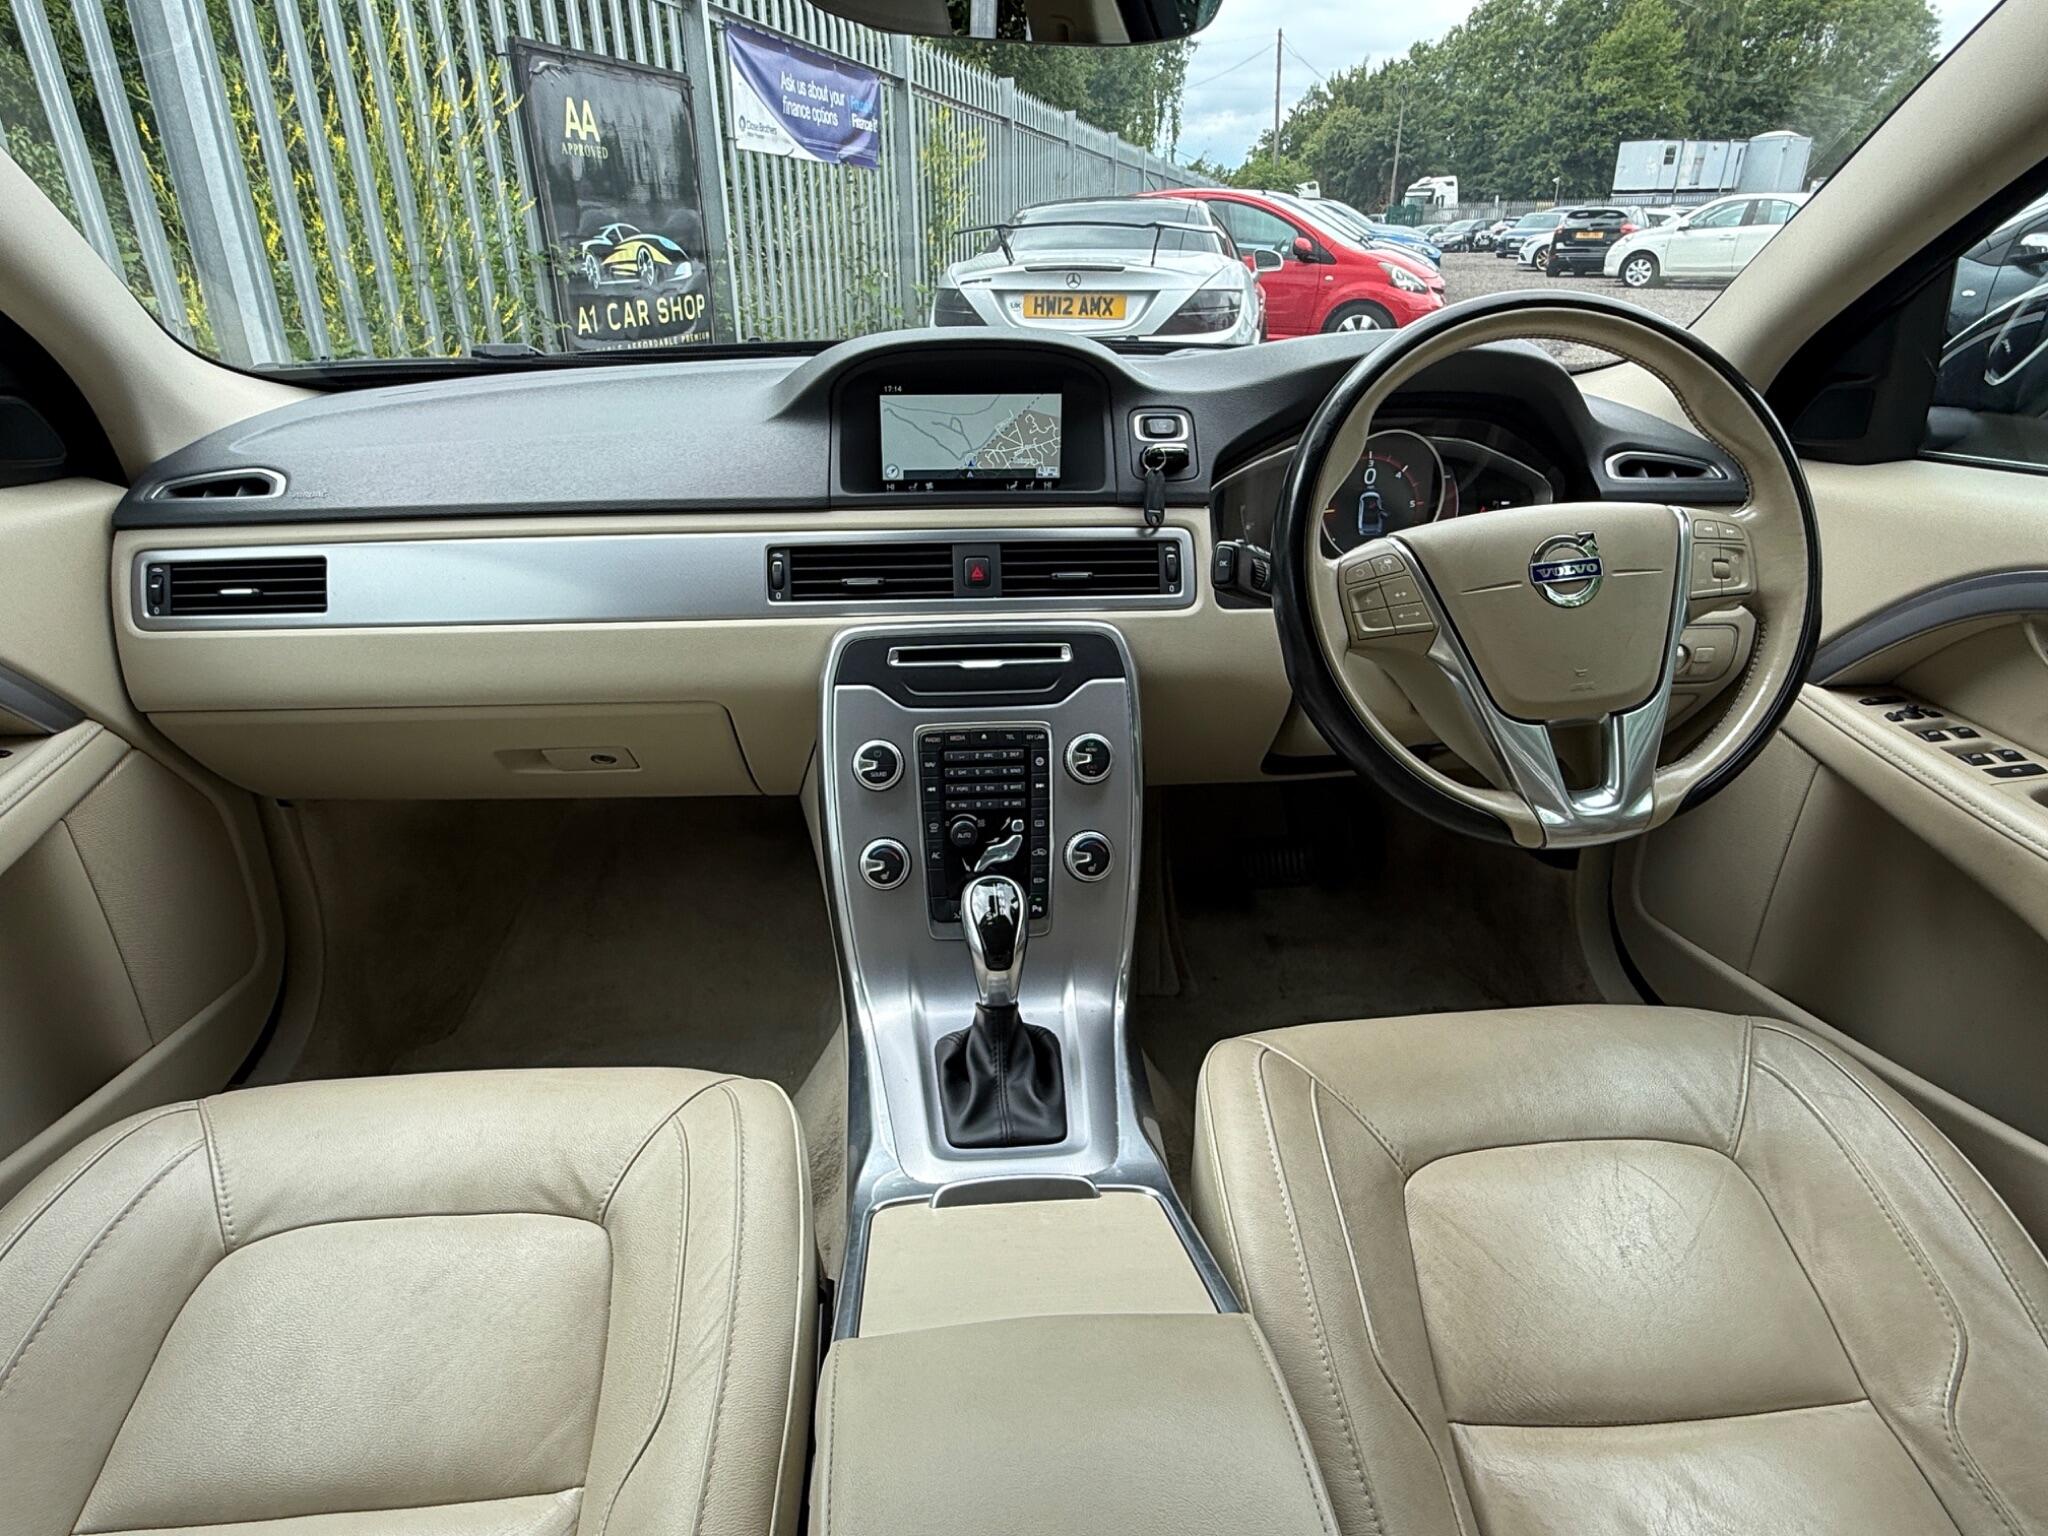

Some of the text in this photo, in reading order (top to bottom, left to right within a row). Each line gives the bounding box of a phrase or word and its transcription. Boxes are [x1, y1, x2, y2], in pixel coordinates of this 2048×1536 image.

[781, 71, 796, 93] Ask
[797, 80, 806, 96] us
[808, 80, 828, 102] about
[829, 90, 845, 108] your
[565, 96, 600, 142] AA
[783, 95, 839, 126] finance options
[561, 142, 609, 159] APPROVED
[578, 294, 705, 336] A1 CAR SHOP
[1033, 296, 1114, 317] HW12 AMX
[884, 385, 902, 393] 17:14
[1364, 468, 1377, 485] 0
[1395, 471, 1402, 479] 4
[1409, 500, 1416, 508] 5
[1536, 562, 1599, 578] VOLVO
